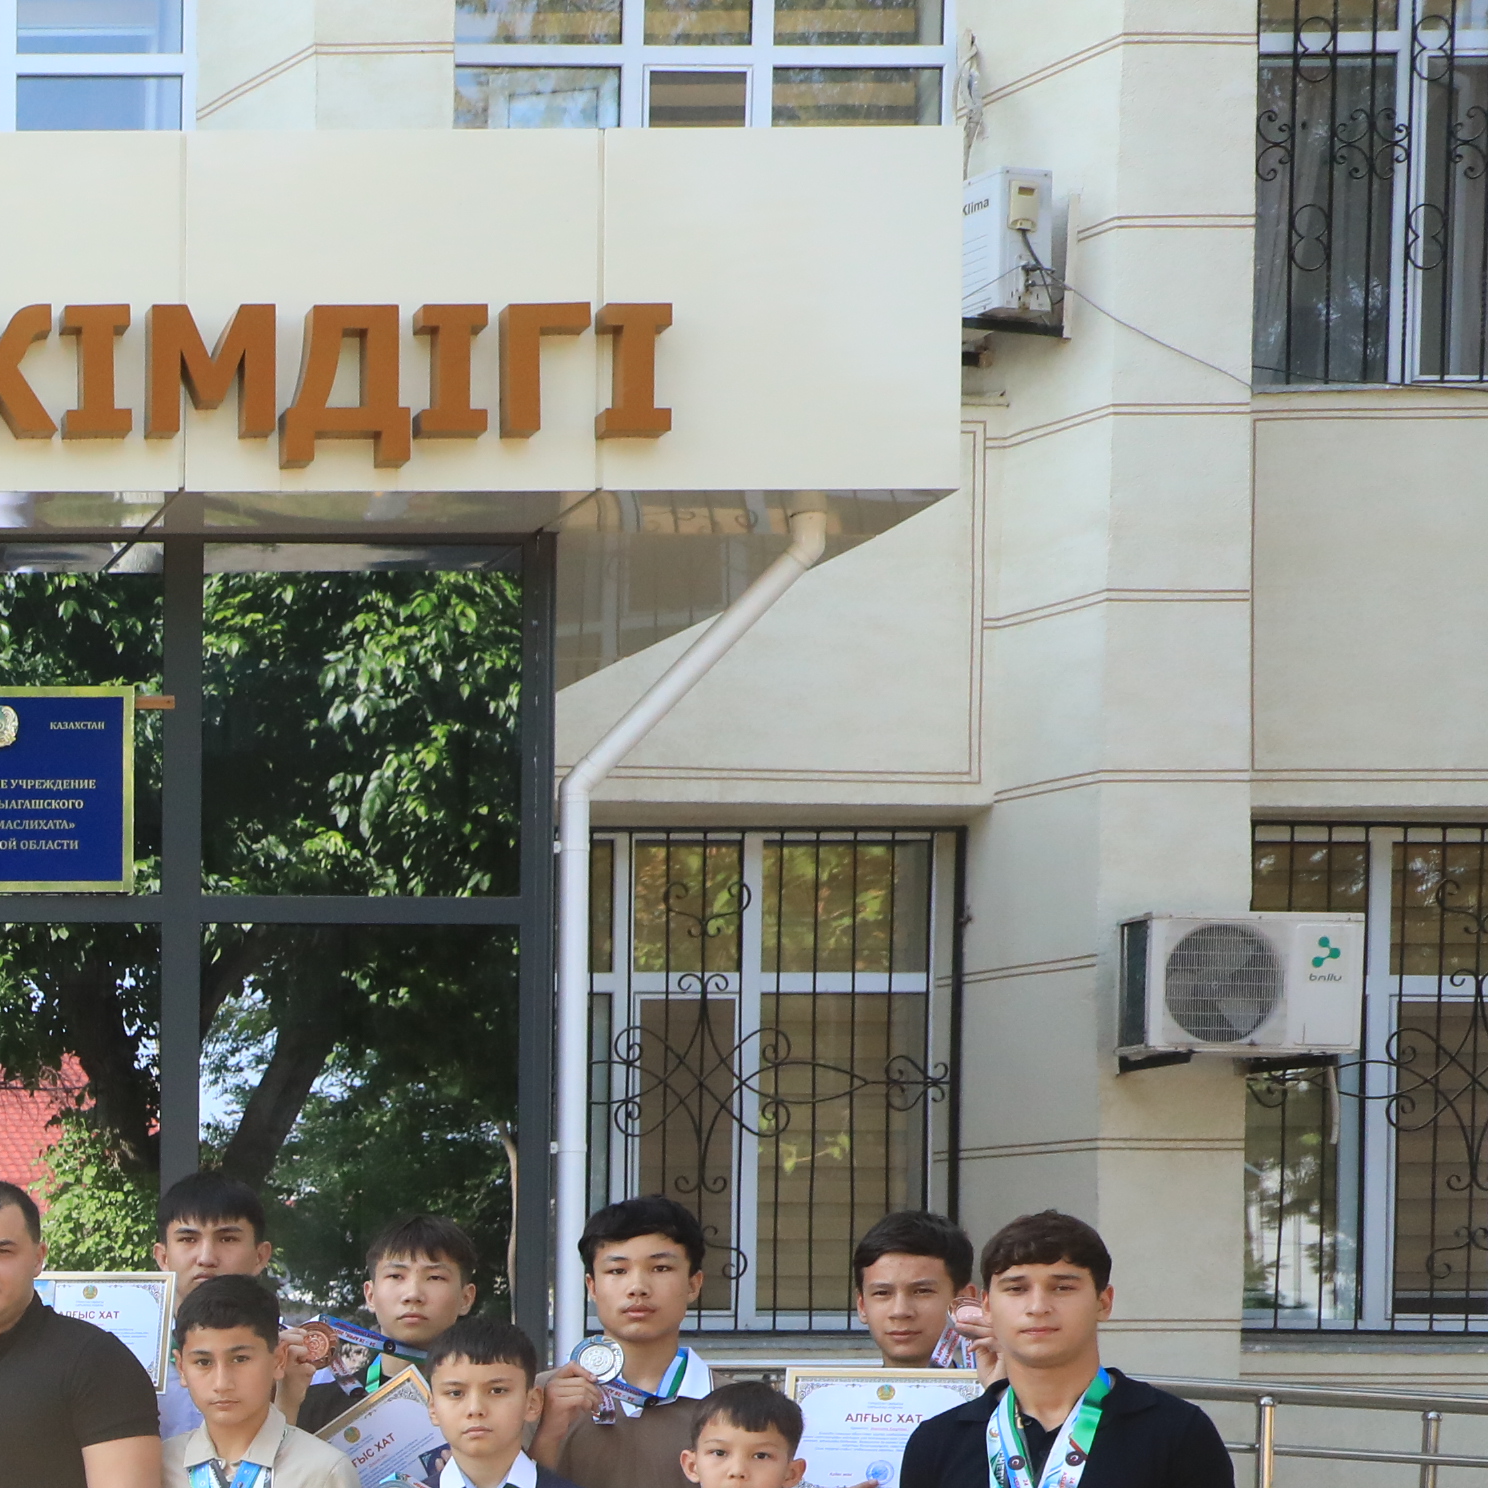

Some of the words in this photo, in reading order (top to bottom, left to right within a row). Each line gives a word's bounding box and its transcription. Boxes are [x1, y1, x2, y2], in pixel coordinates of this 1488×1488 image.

[10, 779, 96, 791] УЧРЕЖДЕНИЕ
[20, 840, 78, 850] ОБЛАСТИ
[98, 1311, 120, 1319] ХАТ
[845, 1413, 892, 1423] АЛҒЫС
[896, 1414, 922, 1423] ХАТ
[374, 1432, 396, 1452] ХАТ
